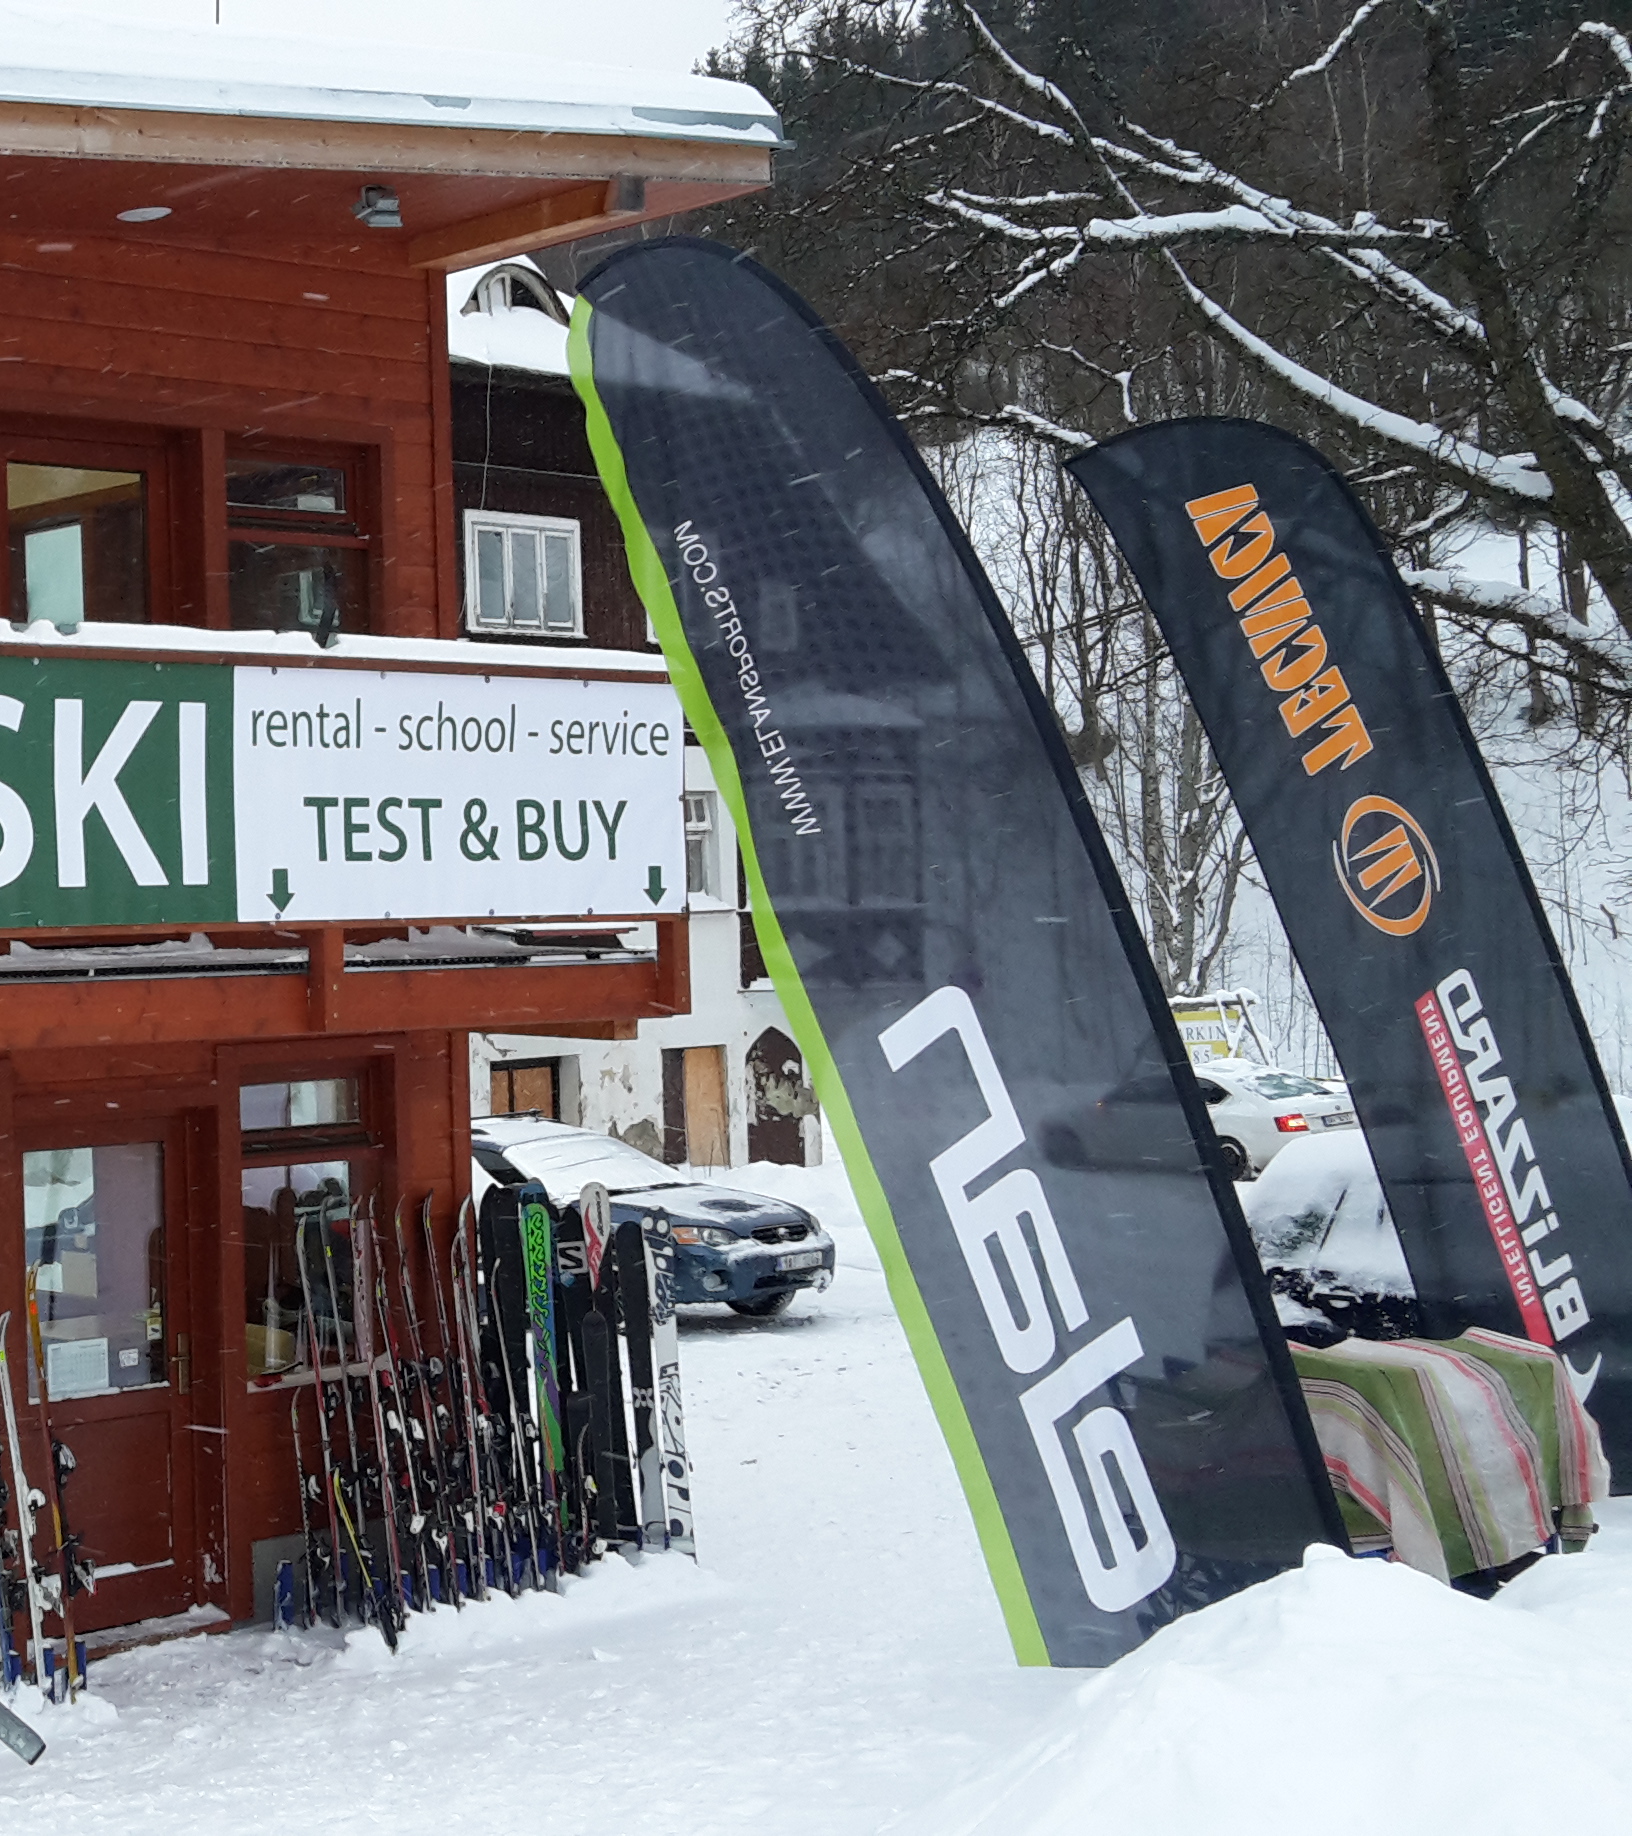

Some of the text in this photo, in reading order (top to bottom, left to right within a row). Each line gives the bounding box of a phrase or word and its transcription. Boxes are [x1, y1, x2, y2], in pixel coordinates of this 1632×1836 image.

[251, 697, 361, 749] rental
[398, 700, 516, 753] school
[549, 704, 670, 757] service
[303, 796, 628, 863] TEST & BUY
